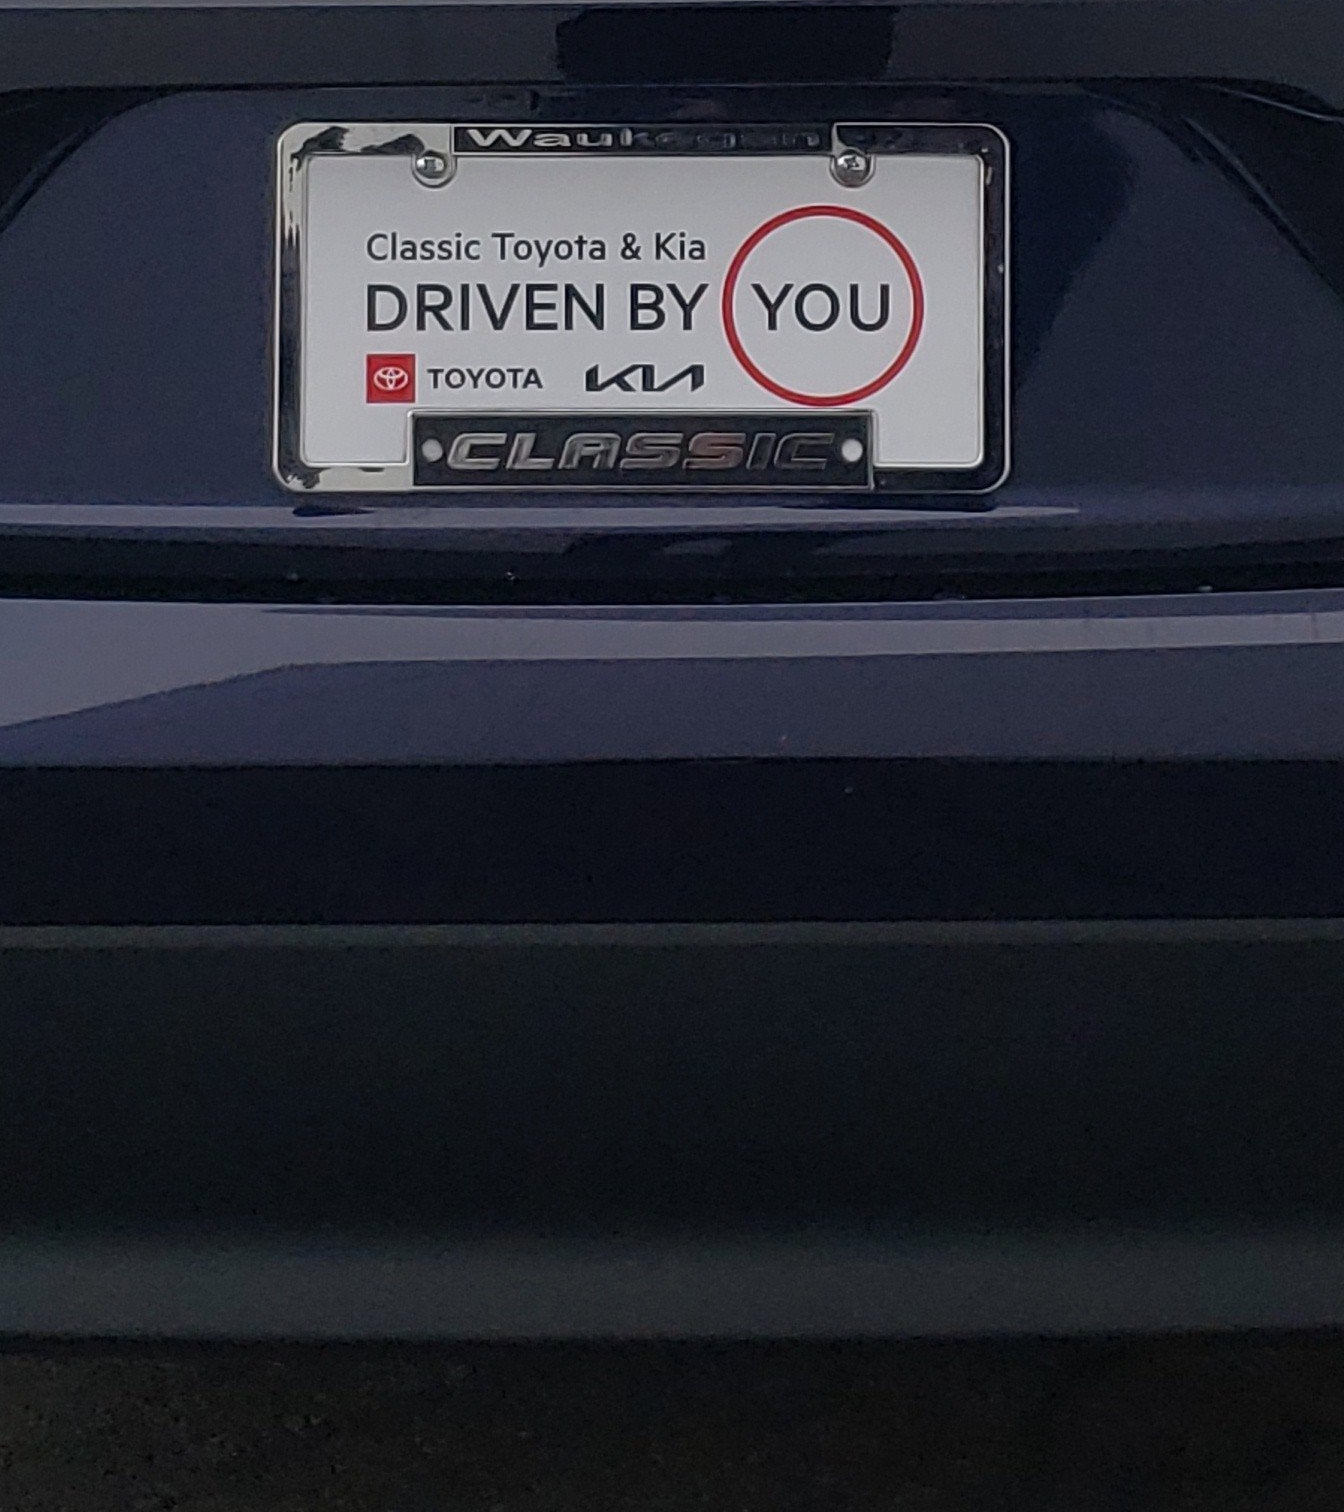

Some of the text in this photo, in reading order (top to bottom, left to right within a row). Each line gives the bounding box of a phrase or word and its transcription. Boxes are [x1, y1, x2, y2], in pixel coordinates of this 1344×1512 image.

[366, 231, 707, 268] Classic Toyota & Kia
[366, 283, 891, 333] DRIVEN BY YOU
[426, 367, 544, 390] TOYOTA
[446, 431, 836, 472] CLASSIC
